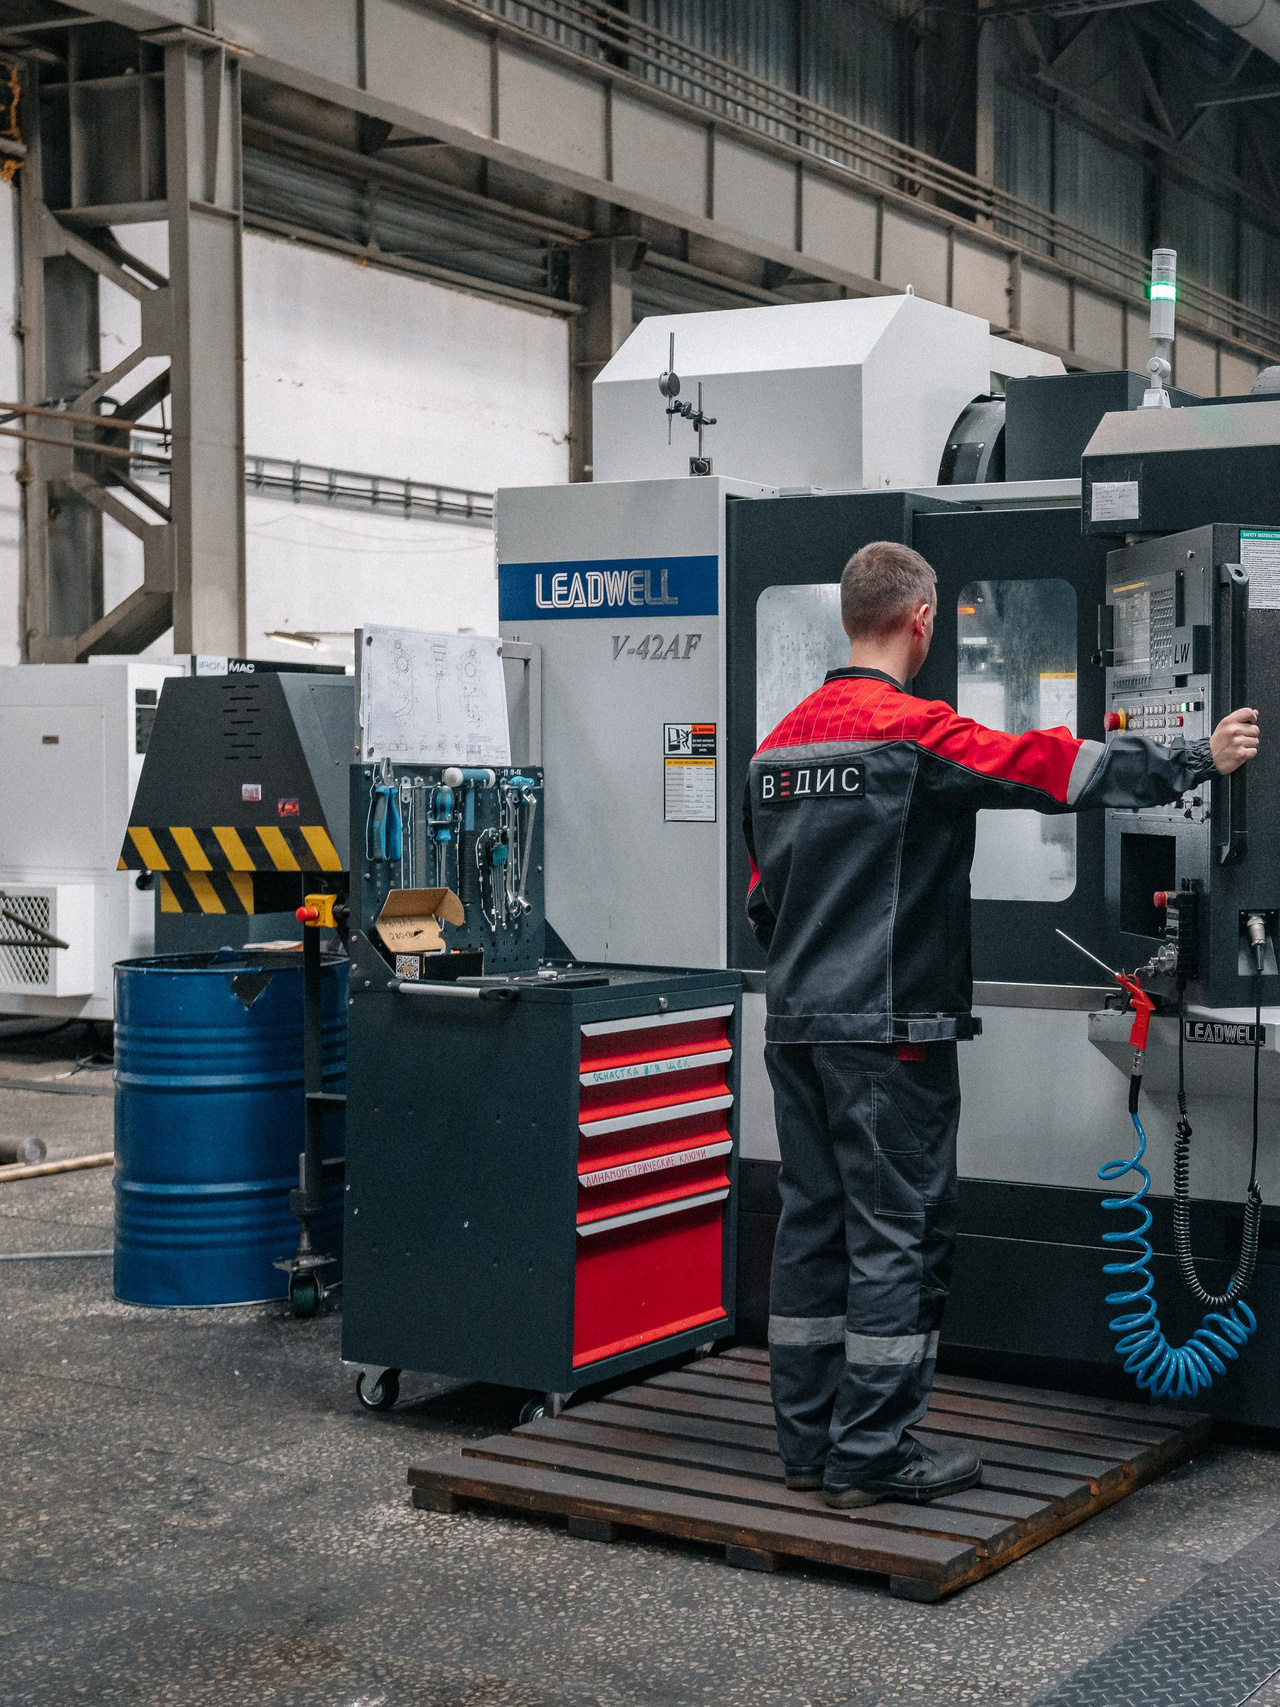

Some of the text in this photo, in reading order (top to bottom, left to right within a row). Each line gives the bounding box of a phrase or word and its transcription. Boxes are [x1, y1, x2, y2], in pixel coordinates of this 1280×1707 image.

[535, 569, 679, 609] LEADWELL
[611, 633, 702, 661] V-42AF
[1174, 642, 1190, 664] LW
[228, 661, 255, 674] MAC
[762, 767, 860, 799] ВЕДИС
[586, 1149, 706, 1187] ДИНАМОМЕТРИЧЕСКИЕ КЛЮЧИ
